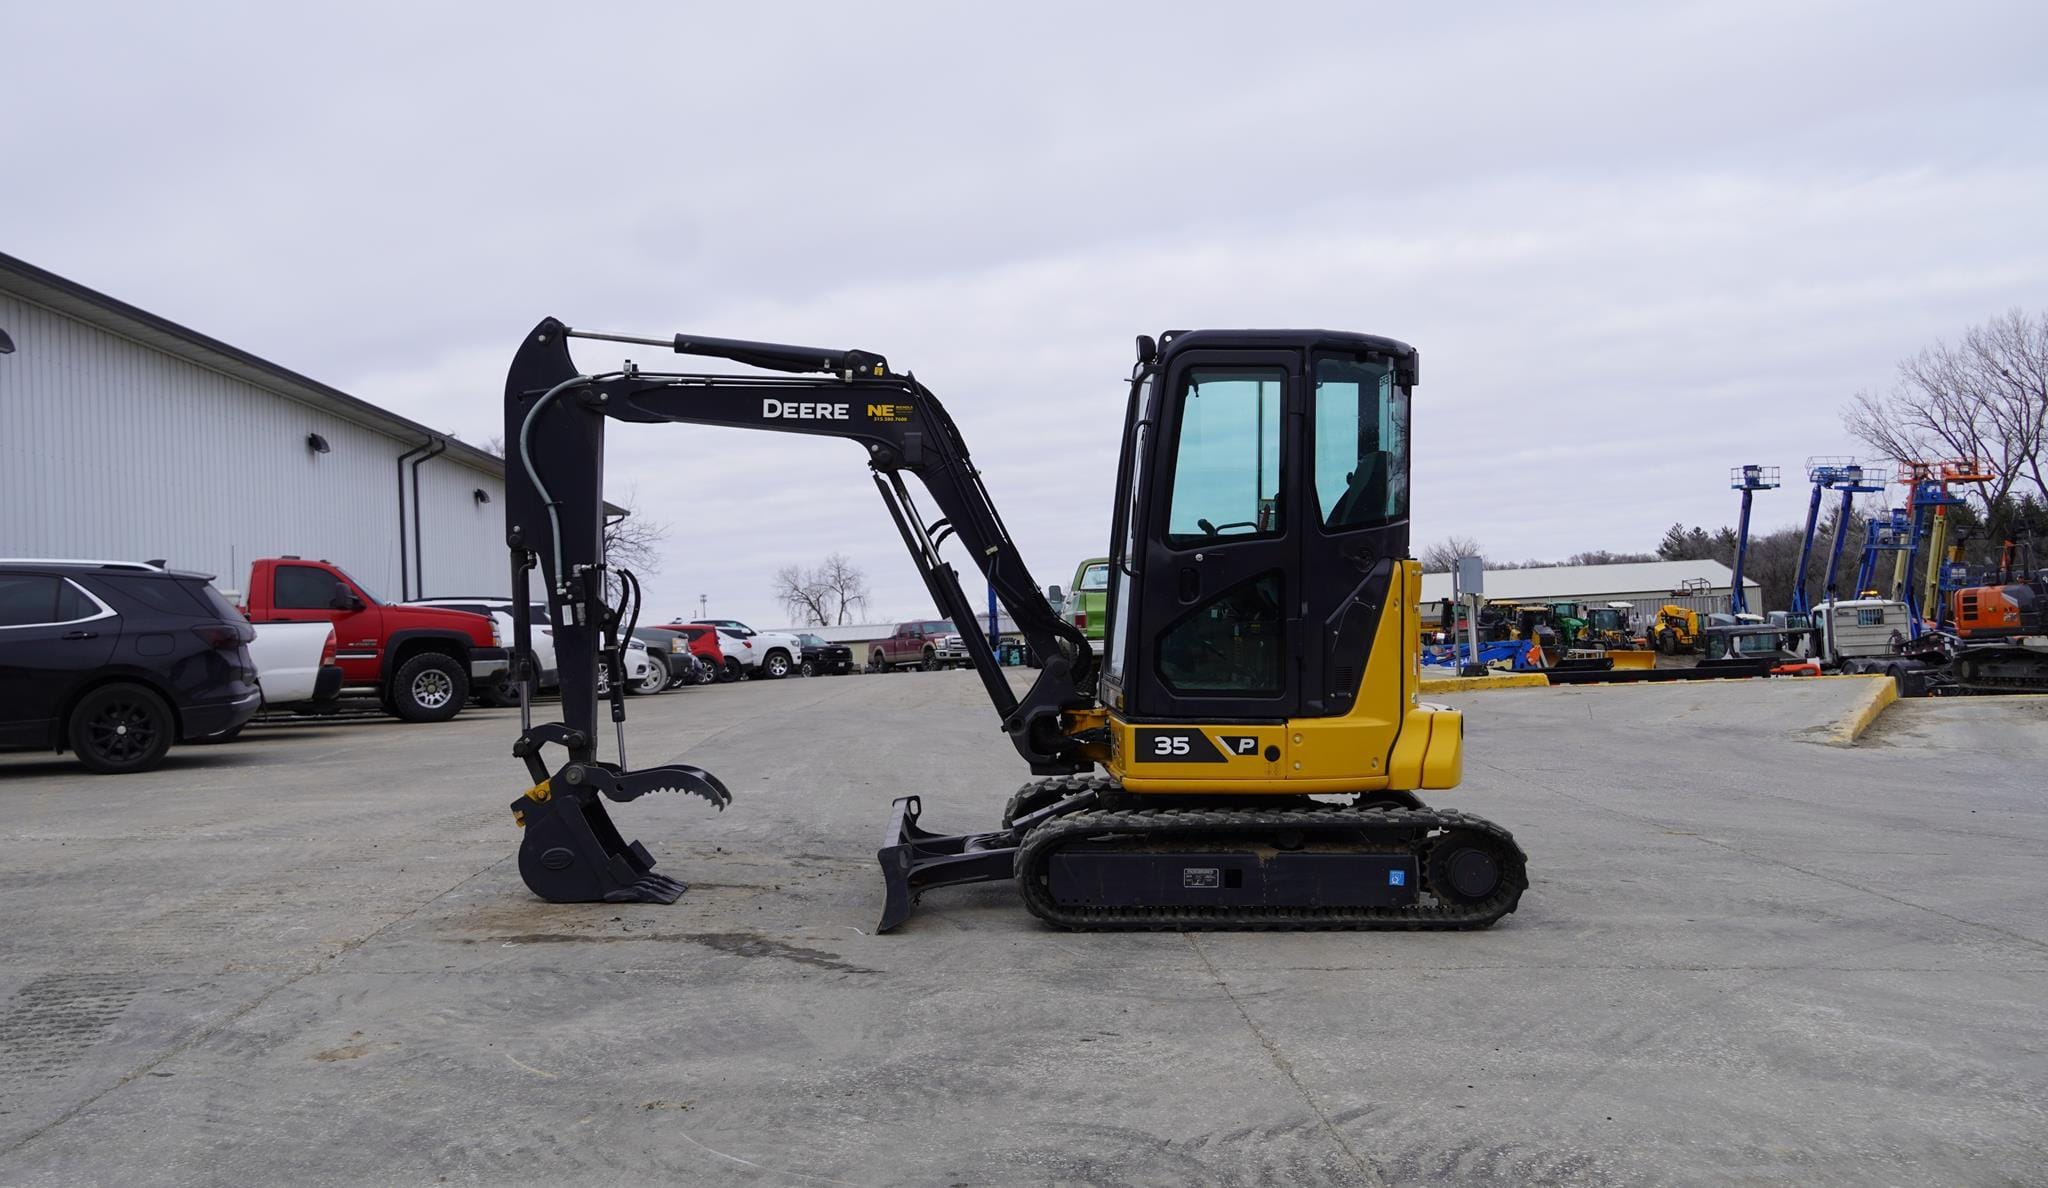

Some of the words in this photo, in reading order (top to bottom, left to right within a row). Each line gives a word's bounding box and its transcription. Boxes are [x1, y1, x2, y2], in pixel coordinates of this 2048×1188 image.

[763, 399, 849, 419] DEERE
[867, 404, 894, 417] NE
[1154, 736, 1190, 755] 35
[1238, 738, 1255, 753] P
